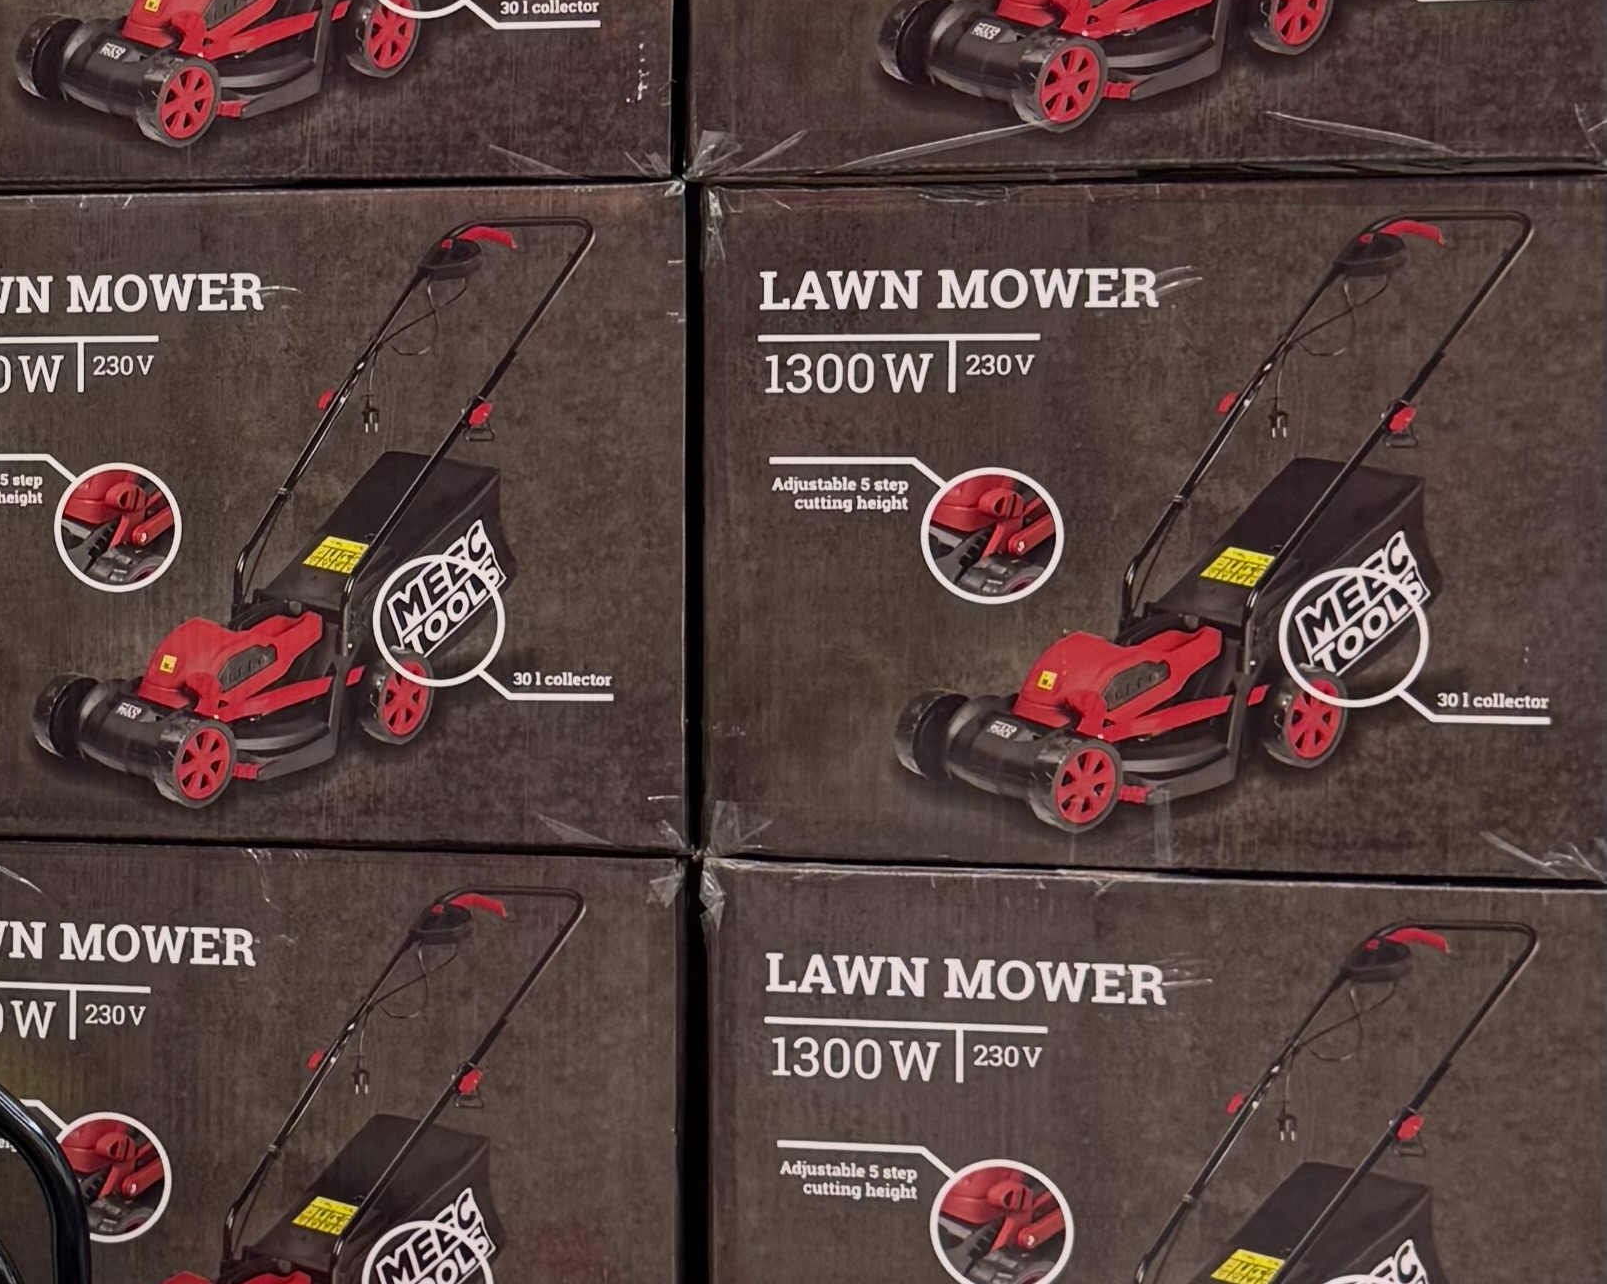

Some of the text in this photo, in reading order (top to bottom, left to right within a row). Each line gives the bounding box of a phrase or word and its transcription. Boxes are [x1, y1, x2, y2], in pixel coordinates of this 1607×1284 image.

[500, 0, 520, 15] 30
[66, 271, 265, 314] MOWER
[759, 267, 1160, 311] LAWN MOWER
[0, 473, 9, 487] 5
[12, 474, 43, 490] step
[771, 476, 909, 495] Adjustable 5 step
[794, 494, 909, 514] cutting height
[388, 521, 488, 635] MEEC
[1437, 692, 1459, 708] 30
[1472, 692, 1550, 709] collector
[59, 922, 256, 967] MOWER
[765, 952, 1167, 1006] LAWN MOWER
[779, 1160, 918, 1184] Adjustable 5 step
[802, 1180, 918, 1202] cutting height
